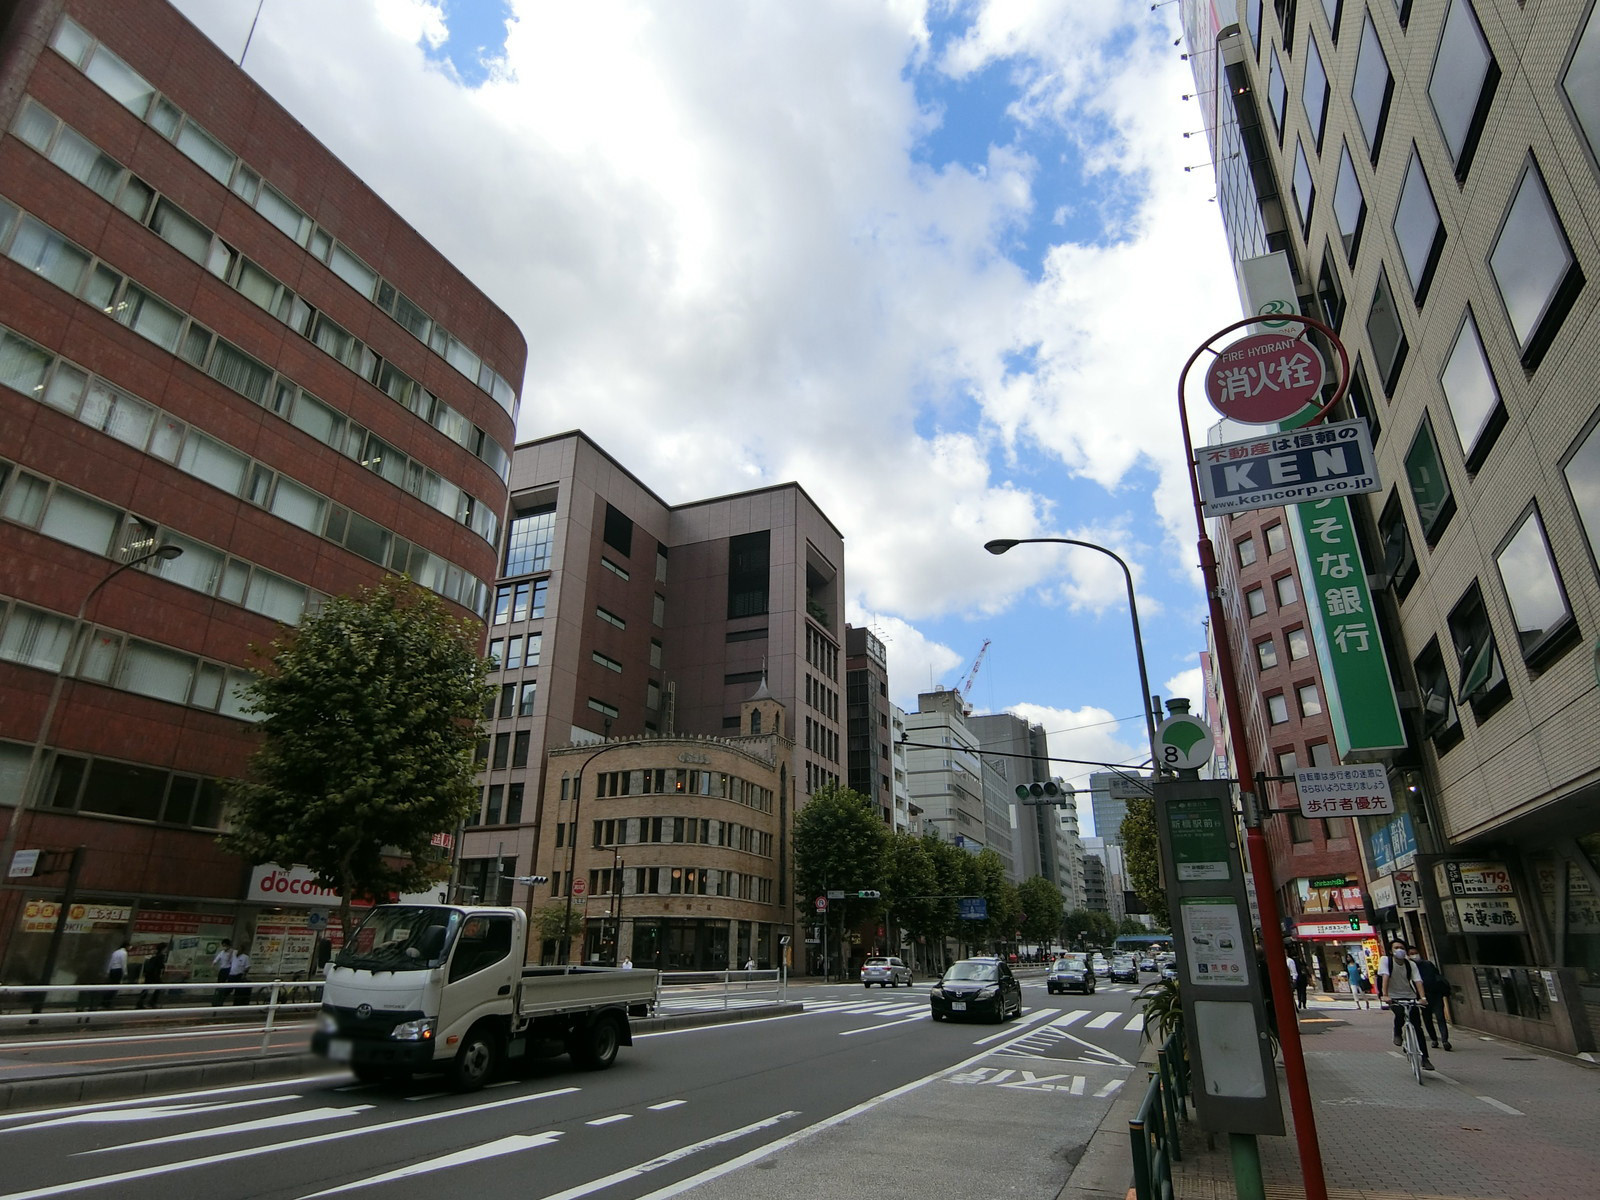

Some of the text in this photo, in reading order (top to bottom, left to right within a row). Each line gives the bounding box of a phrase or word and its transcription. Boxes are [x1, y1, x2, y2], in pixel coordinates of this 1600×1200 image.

[1221, 338, 1297, 363] FIRE HYDRANT
[1216, 352, 1315, 403] 消火栓
[1207, 427, 1359, 463] 不動産は信頼の
[1223, 446, 1349, 492] KEN
[1210, 476, 1374, 510] www.kencorp.co.jp
[1164, 746, 1179, 763] 8
[1298, 768, 1383, 783] 自転車は歩行者の迷惑に
[1301, 780, 1385, 794] ならないように走りましょう
[1307, 795, 1388, 813] 歩行者優先
[1480, 871, 1506, 884] 179
[1497, 884, 1510, 892] 99
